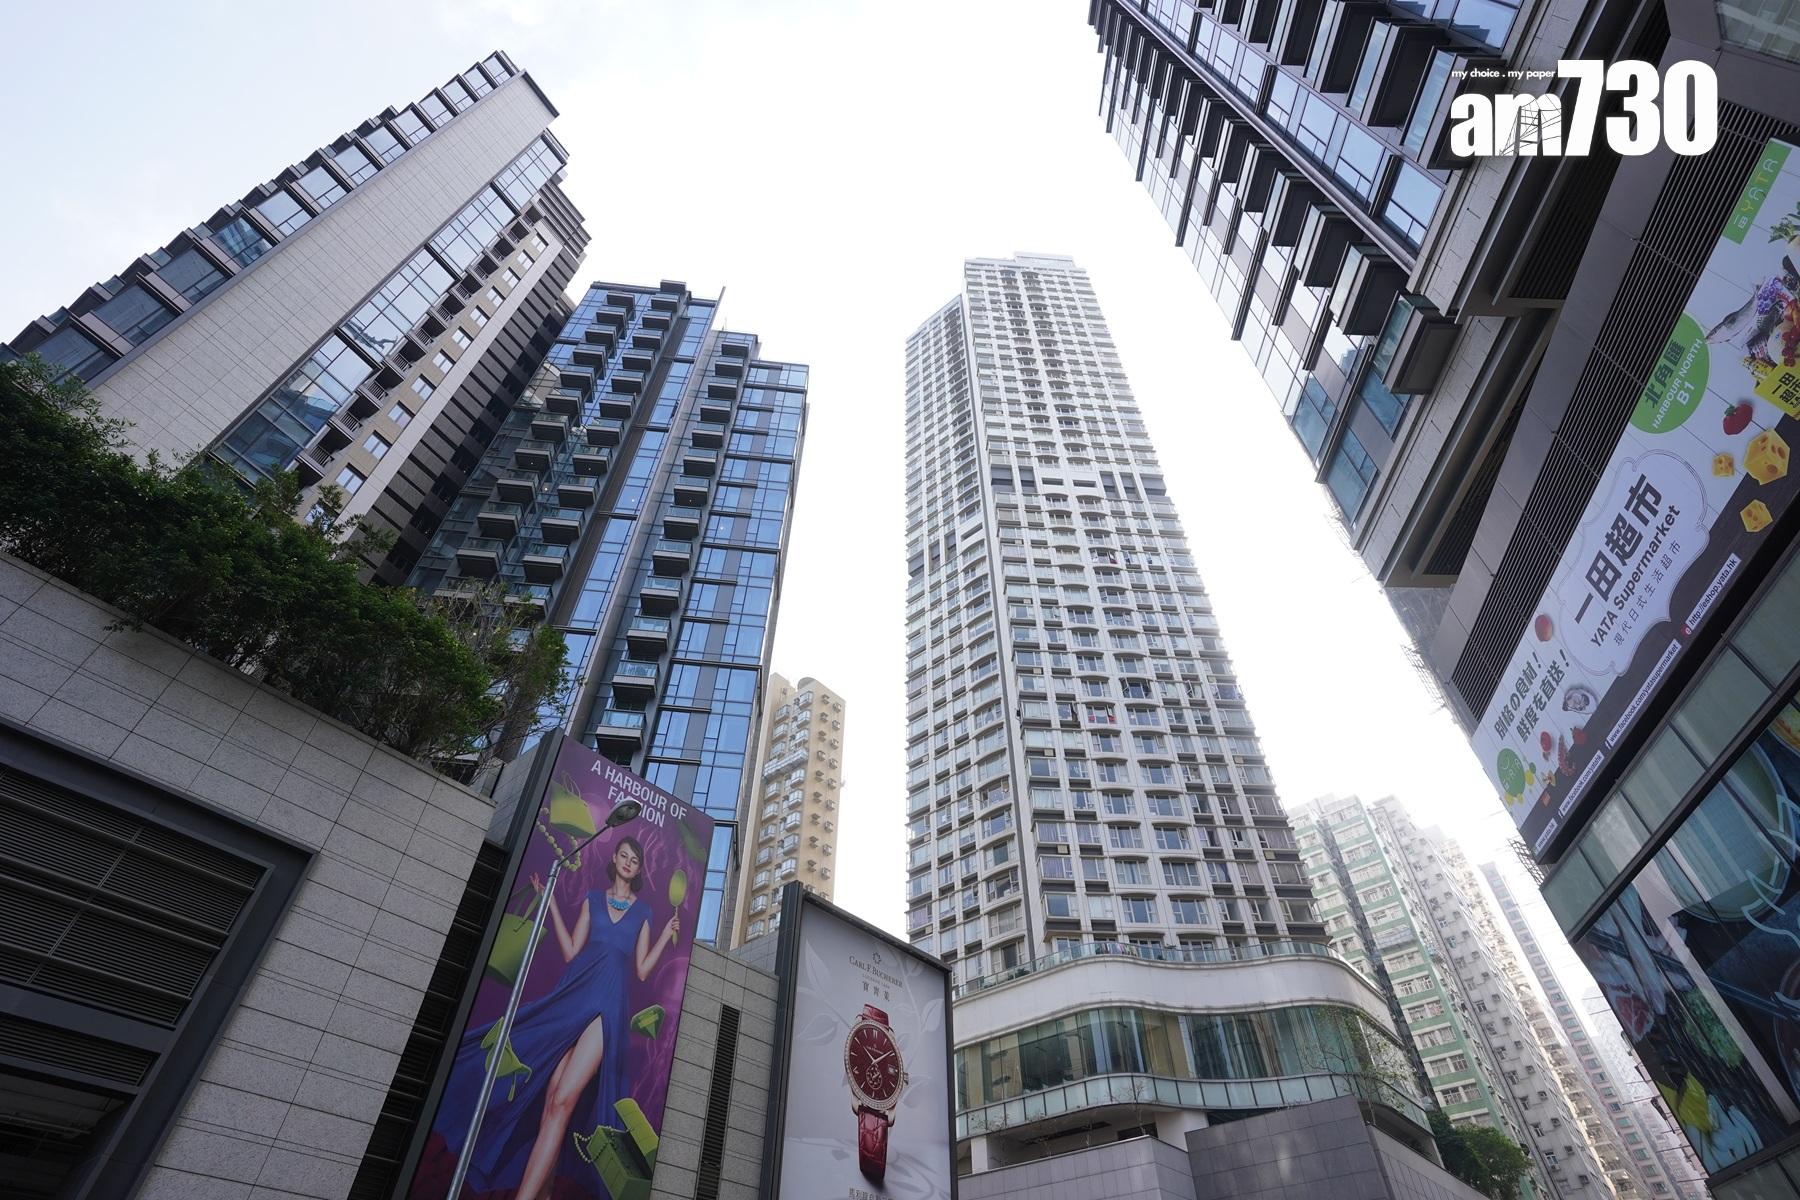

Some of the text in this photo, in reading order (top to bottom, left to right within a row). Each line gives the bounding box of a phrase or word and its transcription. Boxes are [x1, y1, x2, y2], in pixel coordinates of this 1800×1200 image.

[1645, 339, 1685, 409] 北角匯
[1652, 338, 1703, 430] HARBOUR NORTH
[1675, 381, 1696, 406] B1
[1574, 473, 1663, 624] 一田超市
[1589, 505, 1681, 648] YATA Supermarket
[1613, 540, 1682, 647] 現代日式生活超市
[591, 760, 688, 820] A HARBOUR OF
[608, 785, 665, 828] FAION
